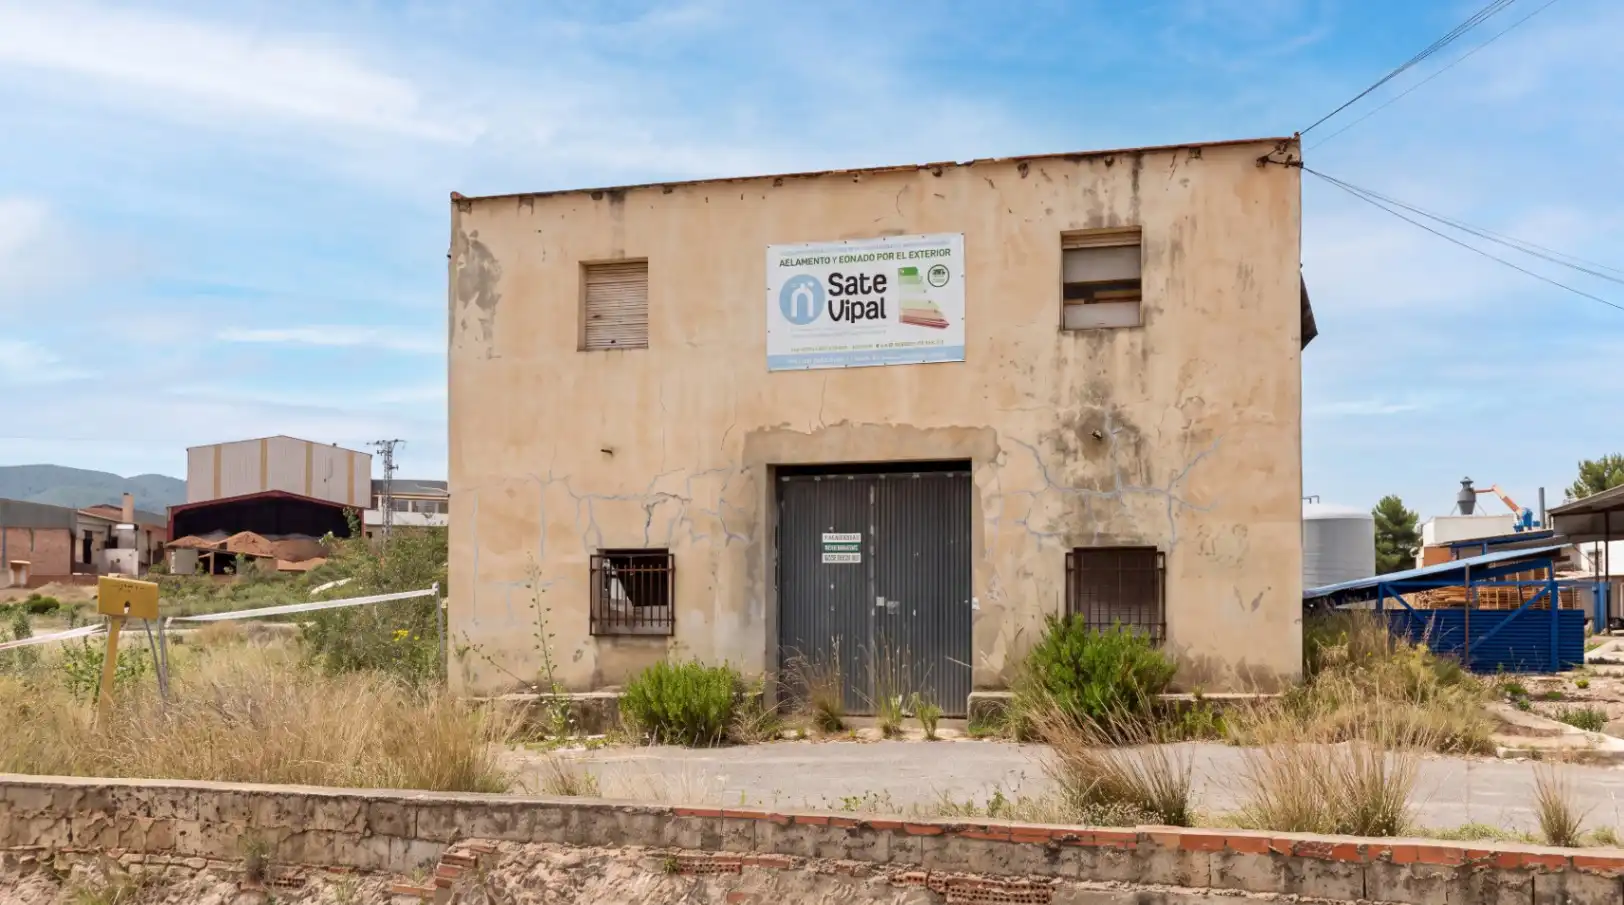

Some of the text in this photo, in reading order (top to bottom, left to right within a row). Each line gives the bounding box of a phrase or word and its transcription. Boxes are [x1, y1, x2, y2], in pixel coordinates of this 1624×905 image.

[832, 256, 838, 264] Y
[876, 252, 895, 261] POR
[896, 251, 907, 260] EL
[908, 248, 951, 259] EXTERIOR
[828, 272, 887, 297] Sate
[828, 297, 886, 323] Vipal
